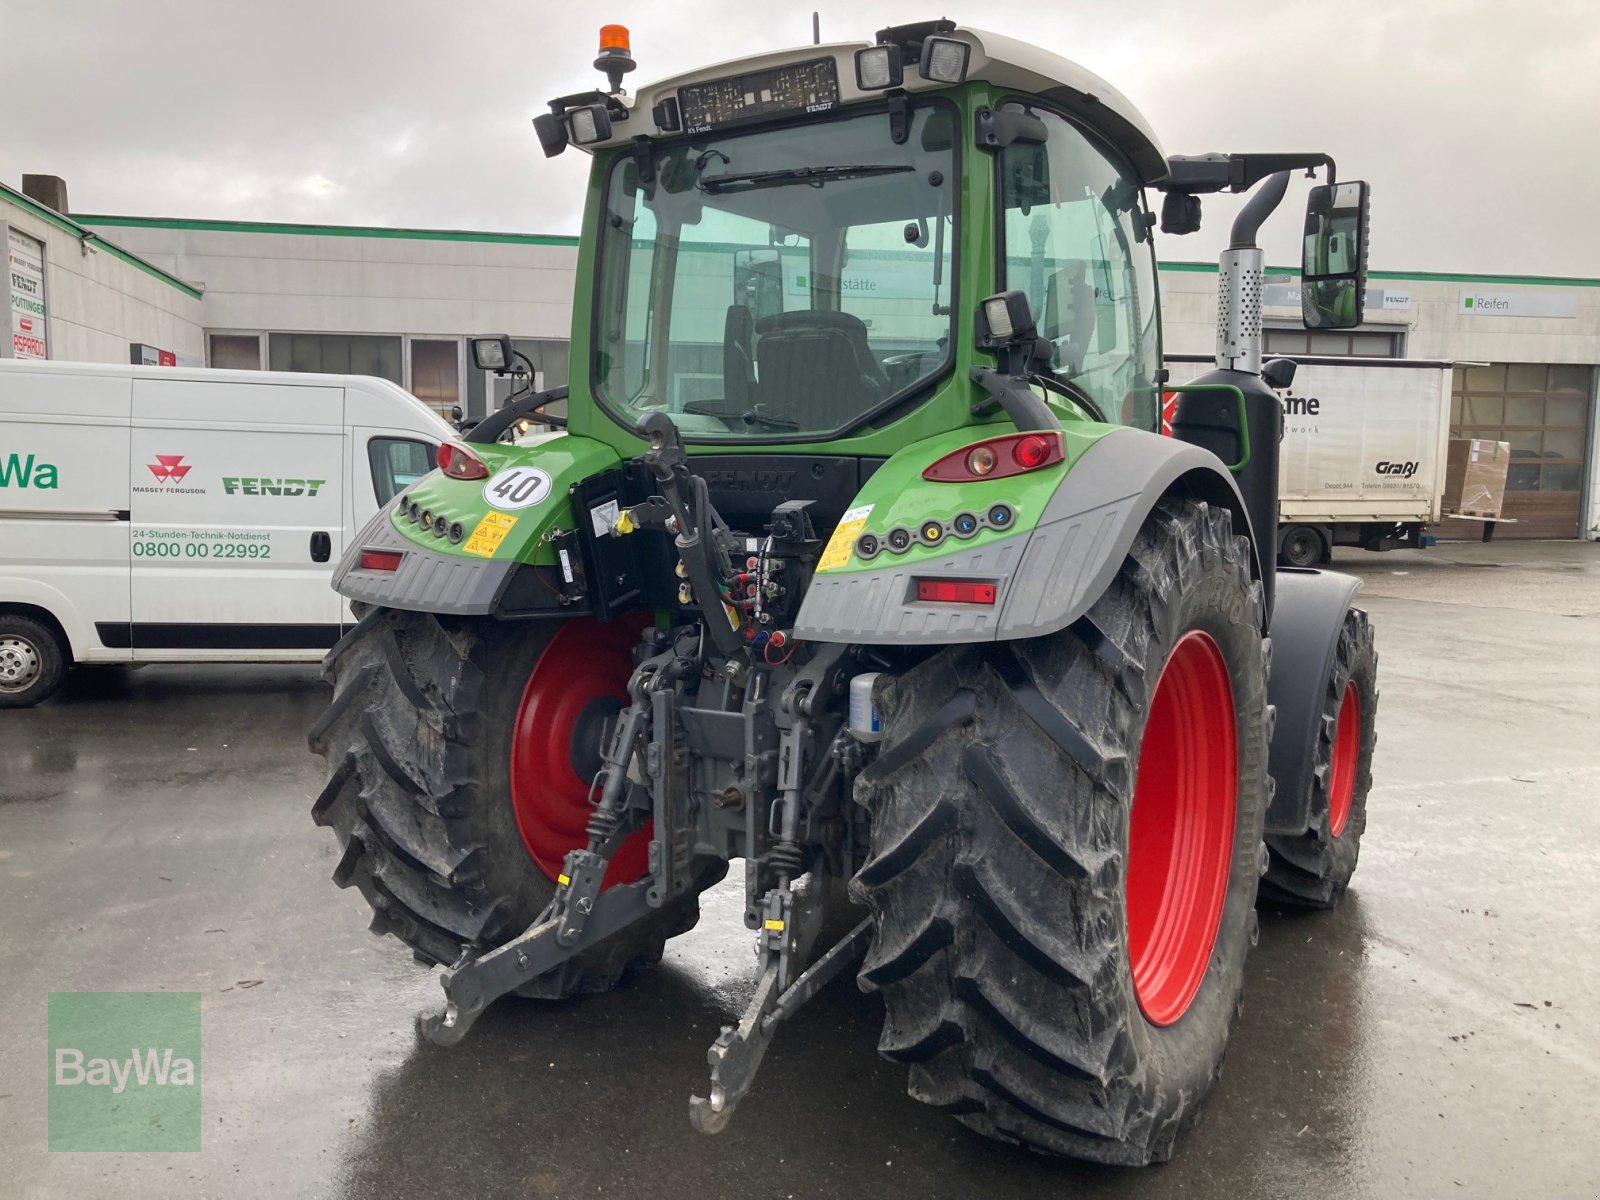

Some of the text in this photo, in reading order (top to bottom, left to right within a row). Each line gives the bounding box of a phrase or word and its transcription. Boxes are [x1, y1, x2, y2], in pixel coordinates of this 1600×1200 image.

[806, 102, 833, 113] FENDT
[11, 273, 38, 294] FENDT
[840, 278, 877, 291] stätte
[1477, 297, 1509, 310] Reifen
[1276, 390, 1320, 416] ine
[132, 486, 206, 495] MASSEY FERGUSON
[222, 477, 326, 497] FENDT
[492, 470, 542, 503] 40
[703, 470, 799, 494] FENDT
[132, 530, 271, 541] 24-Stunden-Technik-Notdienst
[132, 542, 271, 559] 0800 00 22992
